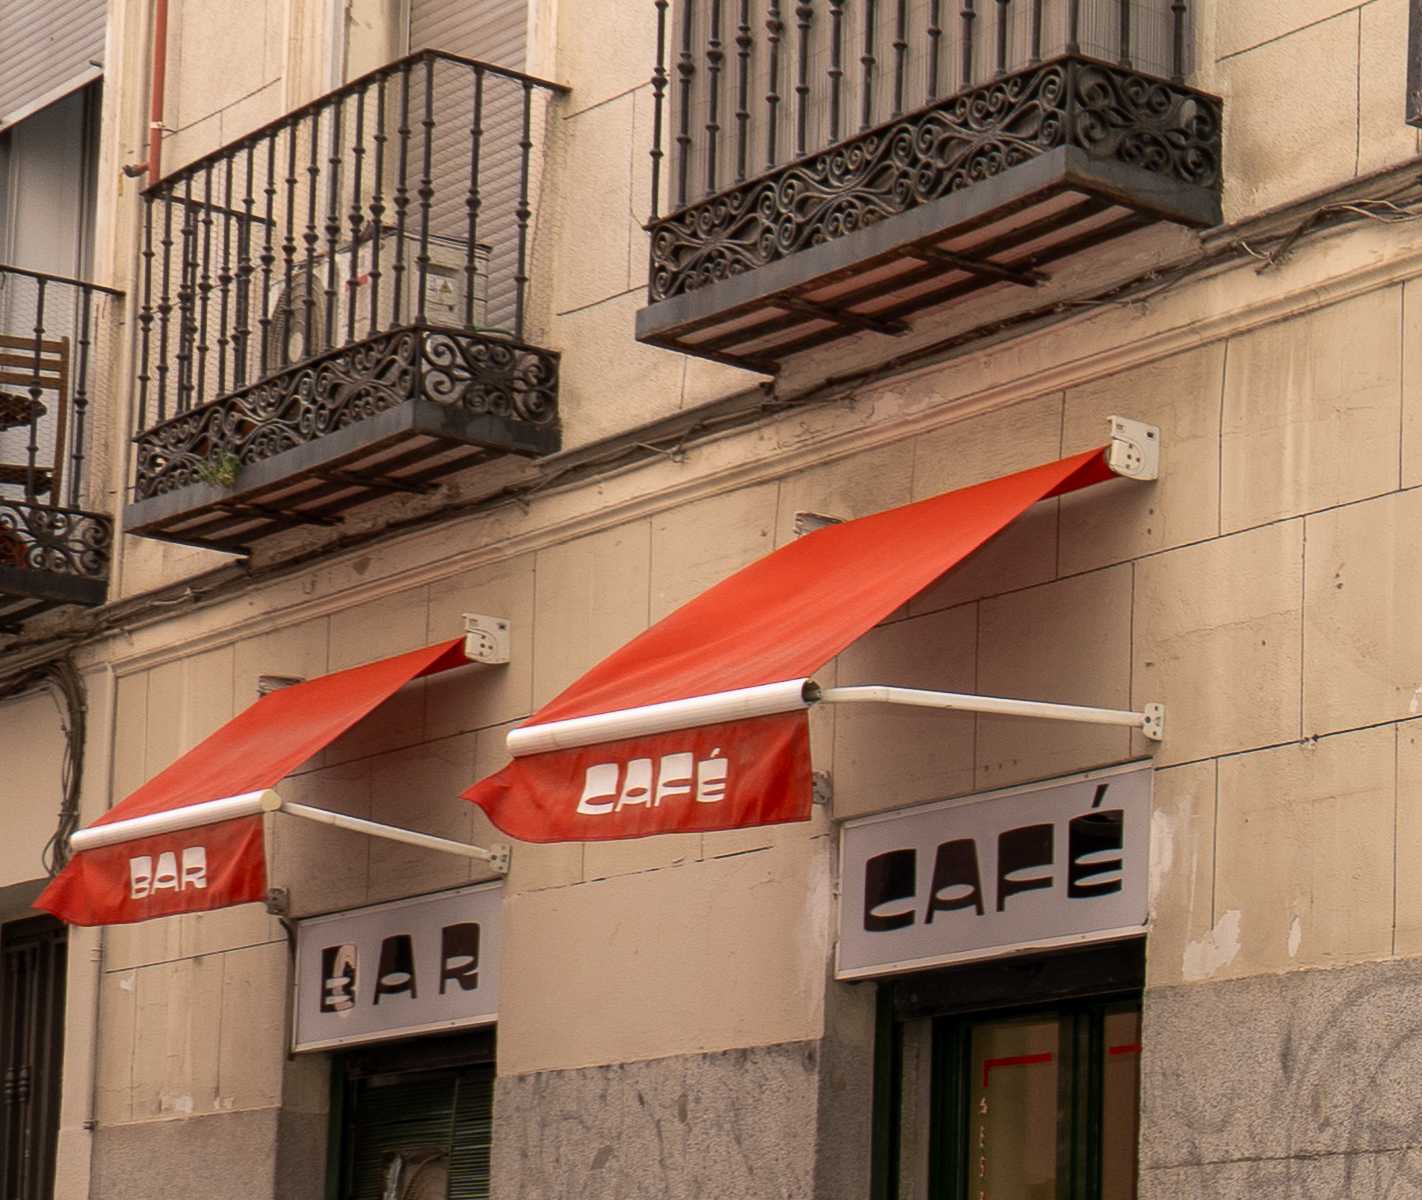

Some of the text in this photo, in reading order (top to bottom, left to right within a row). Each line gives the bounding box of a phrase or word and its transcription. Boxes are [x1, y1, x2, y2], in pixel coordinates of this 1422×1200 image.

[577, 748, 728, 815] CAFÉ
[129, 846, 207, 900] BAR
[864, 784, 1124, 932] CAFÉ
[320, 922, 480, 1013] BAR
